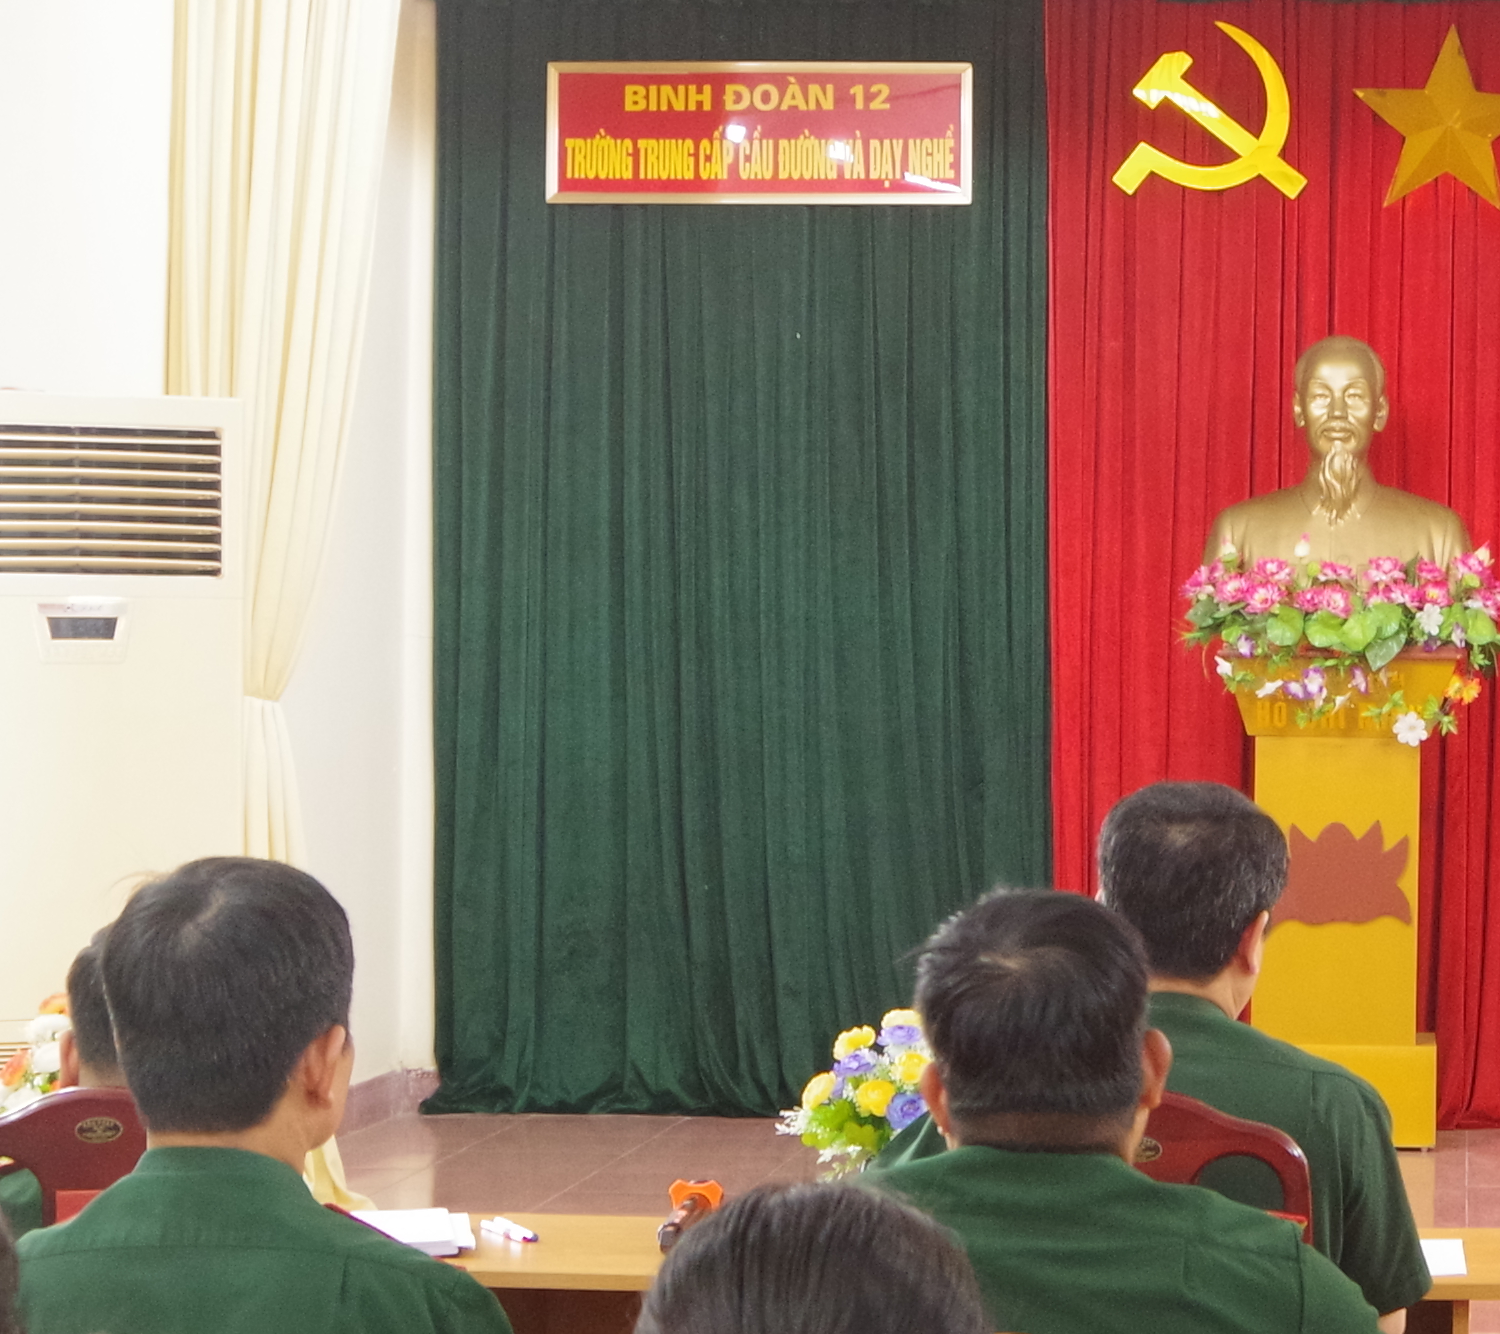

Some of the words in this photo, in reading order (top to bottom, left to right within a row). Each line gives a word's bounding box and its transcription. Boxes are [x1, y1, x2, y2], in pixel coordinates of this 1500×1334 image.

[624, 84, 712, 111] BINH
[723, 76, 835, 111] ĐOÀN
[849, 83, 891, 111] 12
[564, 128, 633, 180] TRƯỜNG
[637, 138, 695, 180] TRUNG
[699, 125, 735, 180] CẤP
[739, 125, 774, 180] CẦU
[777, 128, 837, 180] ĐƯỜNG
[869, 138, 904, 189] DẠY
[907, 124, 956, 180] NGHỀ
